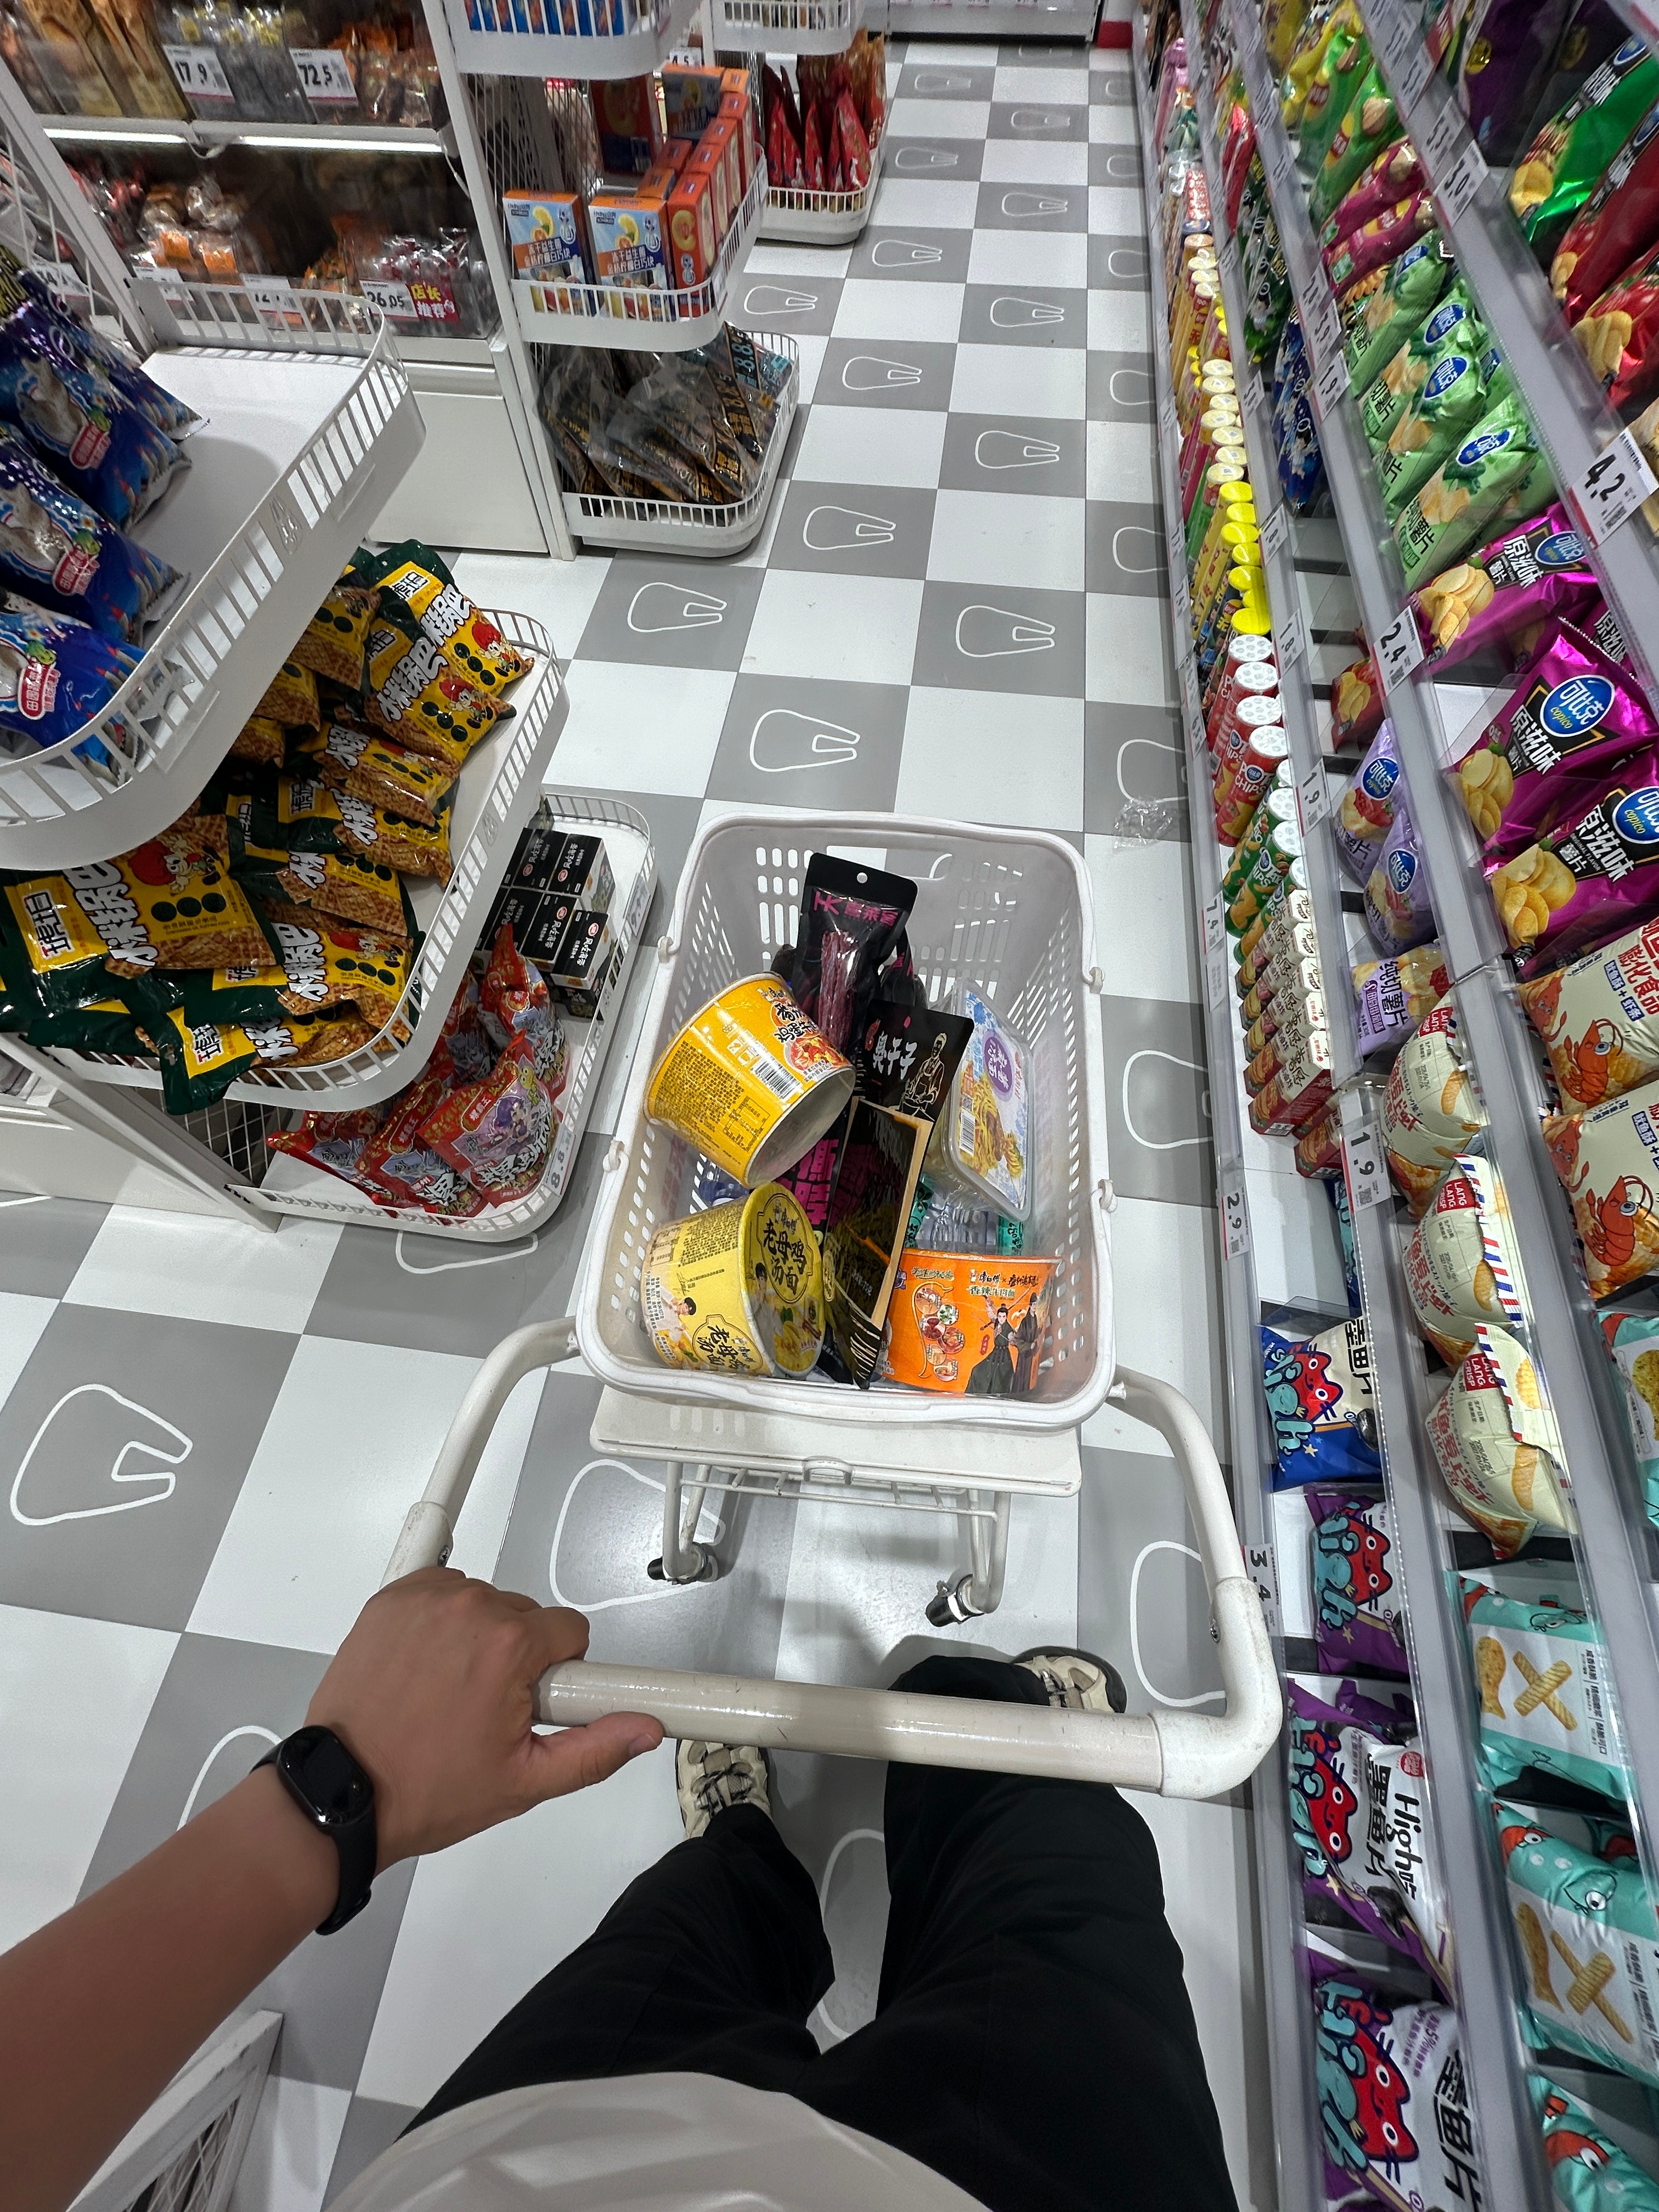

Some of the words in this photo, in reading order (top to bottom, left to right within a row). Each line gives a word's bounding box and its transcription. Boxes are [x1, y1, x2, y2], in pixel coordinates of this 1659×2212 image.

[1442, 157, 1471, 204] 3.0
[410, 284, 442, 301] 店长
[1311, 311, 1331, 350] 3.9
[1317, 362, 1339, 401] 1.9
[1585, 454, 1626, 500] 4.2
[1263, 513, 1279, 548] 1.8
[1503, 534, 1544, 589] 原滋味
[1279, 620, 1295, 657] 1.8
[1379, 619, 1408, 669] 2.4
[378, 635, 448, 723] 小米锅巴
[1550, 706, 1574, 730] copico
[1559, 679, 1605, 726] 可比克
[1509, 704, 1564, 775] 原滋味
[1235, 774, 1267, 795] CHIPS
[1302, 769, 1321, 812] 1.9
[1624, 808, 1645, 835] copico
[1559, 842, 1587, 873] 薯片
[1569, 832, 1587, 854] ORIGINAL
[1584, 851, 1602, 872] FLAVOR
[1576, 804, 1635, 883] 原滋味
[63, 860, 158, 968] 小米锅巴
[1205, 898, 1219, 932] 7.4
[272, 922, 330, 1002] 小米锅巴
[576, 936, 594, 967] 风吃海带
[1379, 959, 1409, 1028] 纯切薯片
[1604, 961, 1626, 991] 鱿鱼酥
[1622, 996, 1645, 1020] 虾条
[1617, 945, 1659, 1015] 膨化食品
[872, 1031, 918, 1080] 臭干子
[1289, 1046, 1310, 1086] 薯愿
[1632, 1111, 1657, 1146] 鱿鱼酥
[1351, 1131, 1375, 1176] 1.9
[1227, 1192, 1242, 1229] 2.9
[1446, 1183, 1457, 1208] LANG
[1454, 1181, 1468, 1206] LANG
[763, 1220, 808, 1274] 老母鸡
[771, 1258, 799, 1295] 汤面
[969, 1285, 1015, 1297] 香辣牛肉面
[1464, 1360, 1476, 1387] CRISP
[1470, 1357, 1486, 1387] LANG
[1248, 1551, 1271, 1601] 3.4
[1364, 1753, 1392, 1877] 墨鱼片
